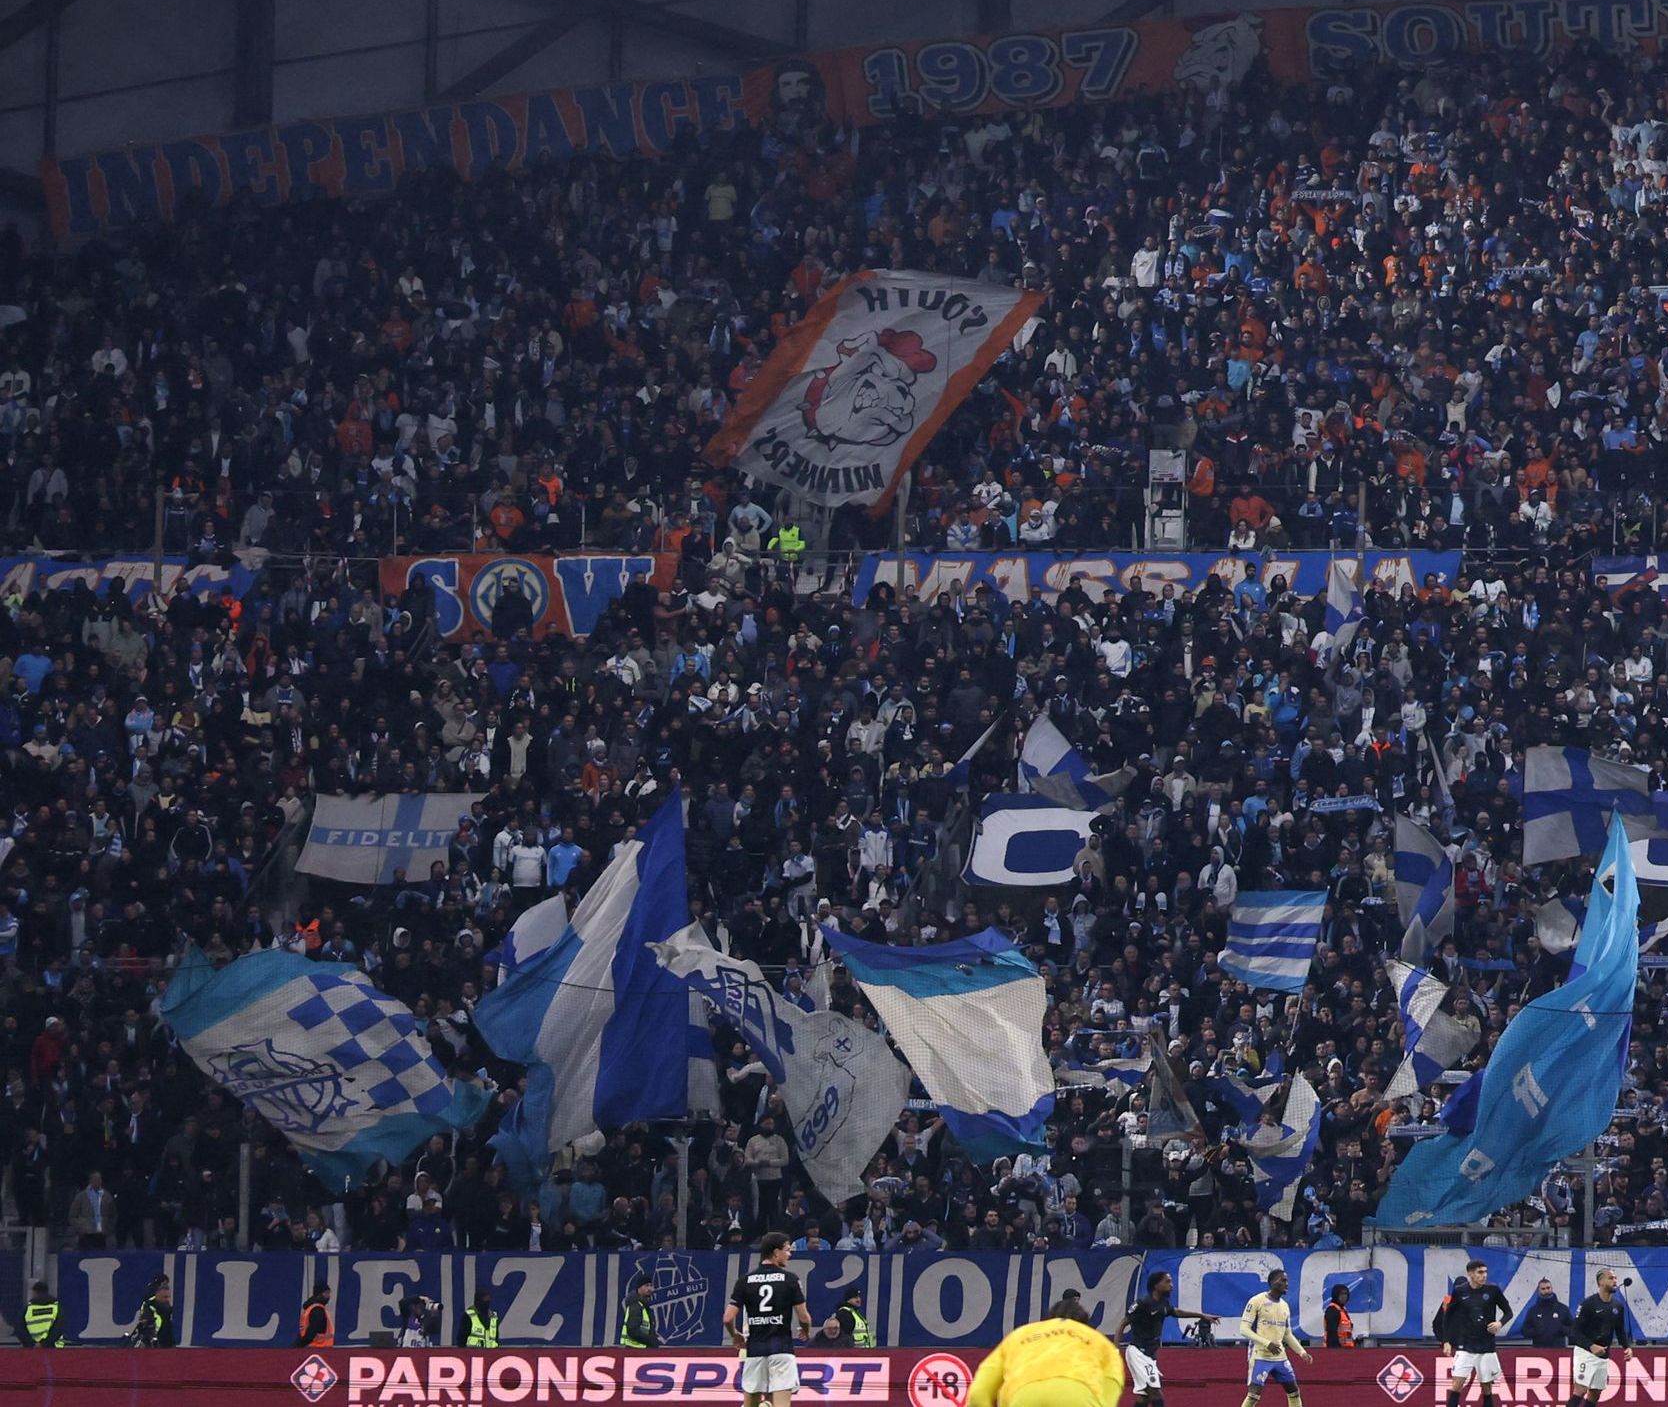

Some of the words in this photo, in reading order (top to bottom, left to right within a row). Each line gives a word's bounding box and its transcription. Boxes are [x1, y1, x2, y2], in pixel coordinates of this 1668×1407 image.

[862, 27, 1139, 116] 1987
[58, 75, 746, 232] INDEPENDANCE
[326, 830, 452, 848] FIDELIT
[971, 807, 1101, 886] C
[799, 1085, 839, 1151] 899
[666, 1287, 679, 1297] AU
[685, 1282, 705, 1294] BUT
[747, 1273, 786, 1284] NICOLAISEN
[759, 1284, 774, 1312] 2
[348, 1355, 617, 1402] PARIONS
[630, 1362, 884, 1396] SPRT
[1144, 1364, 1155, 1376] 12
[1578, 1362, 1586, 1373] 9
